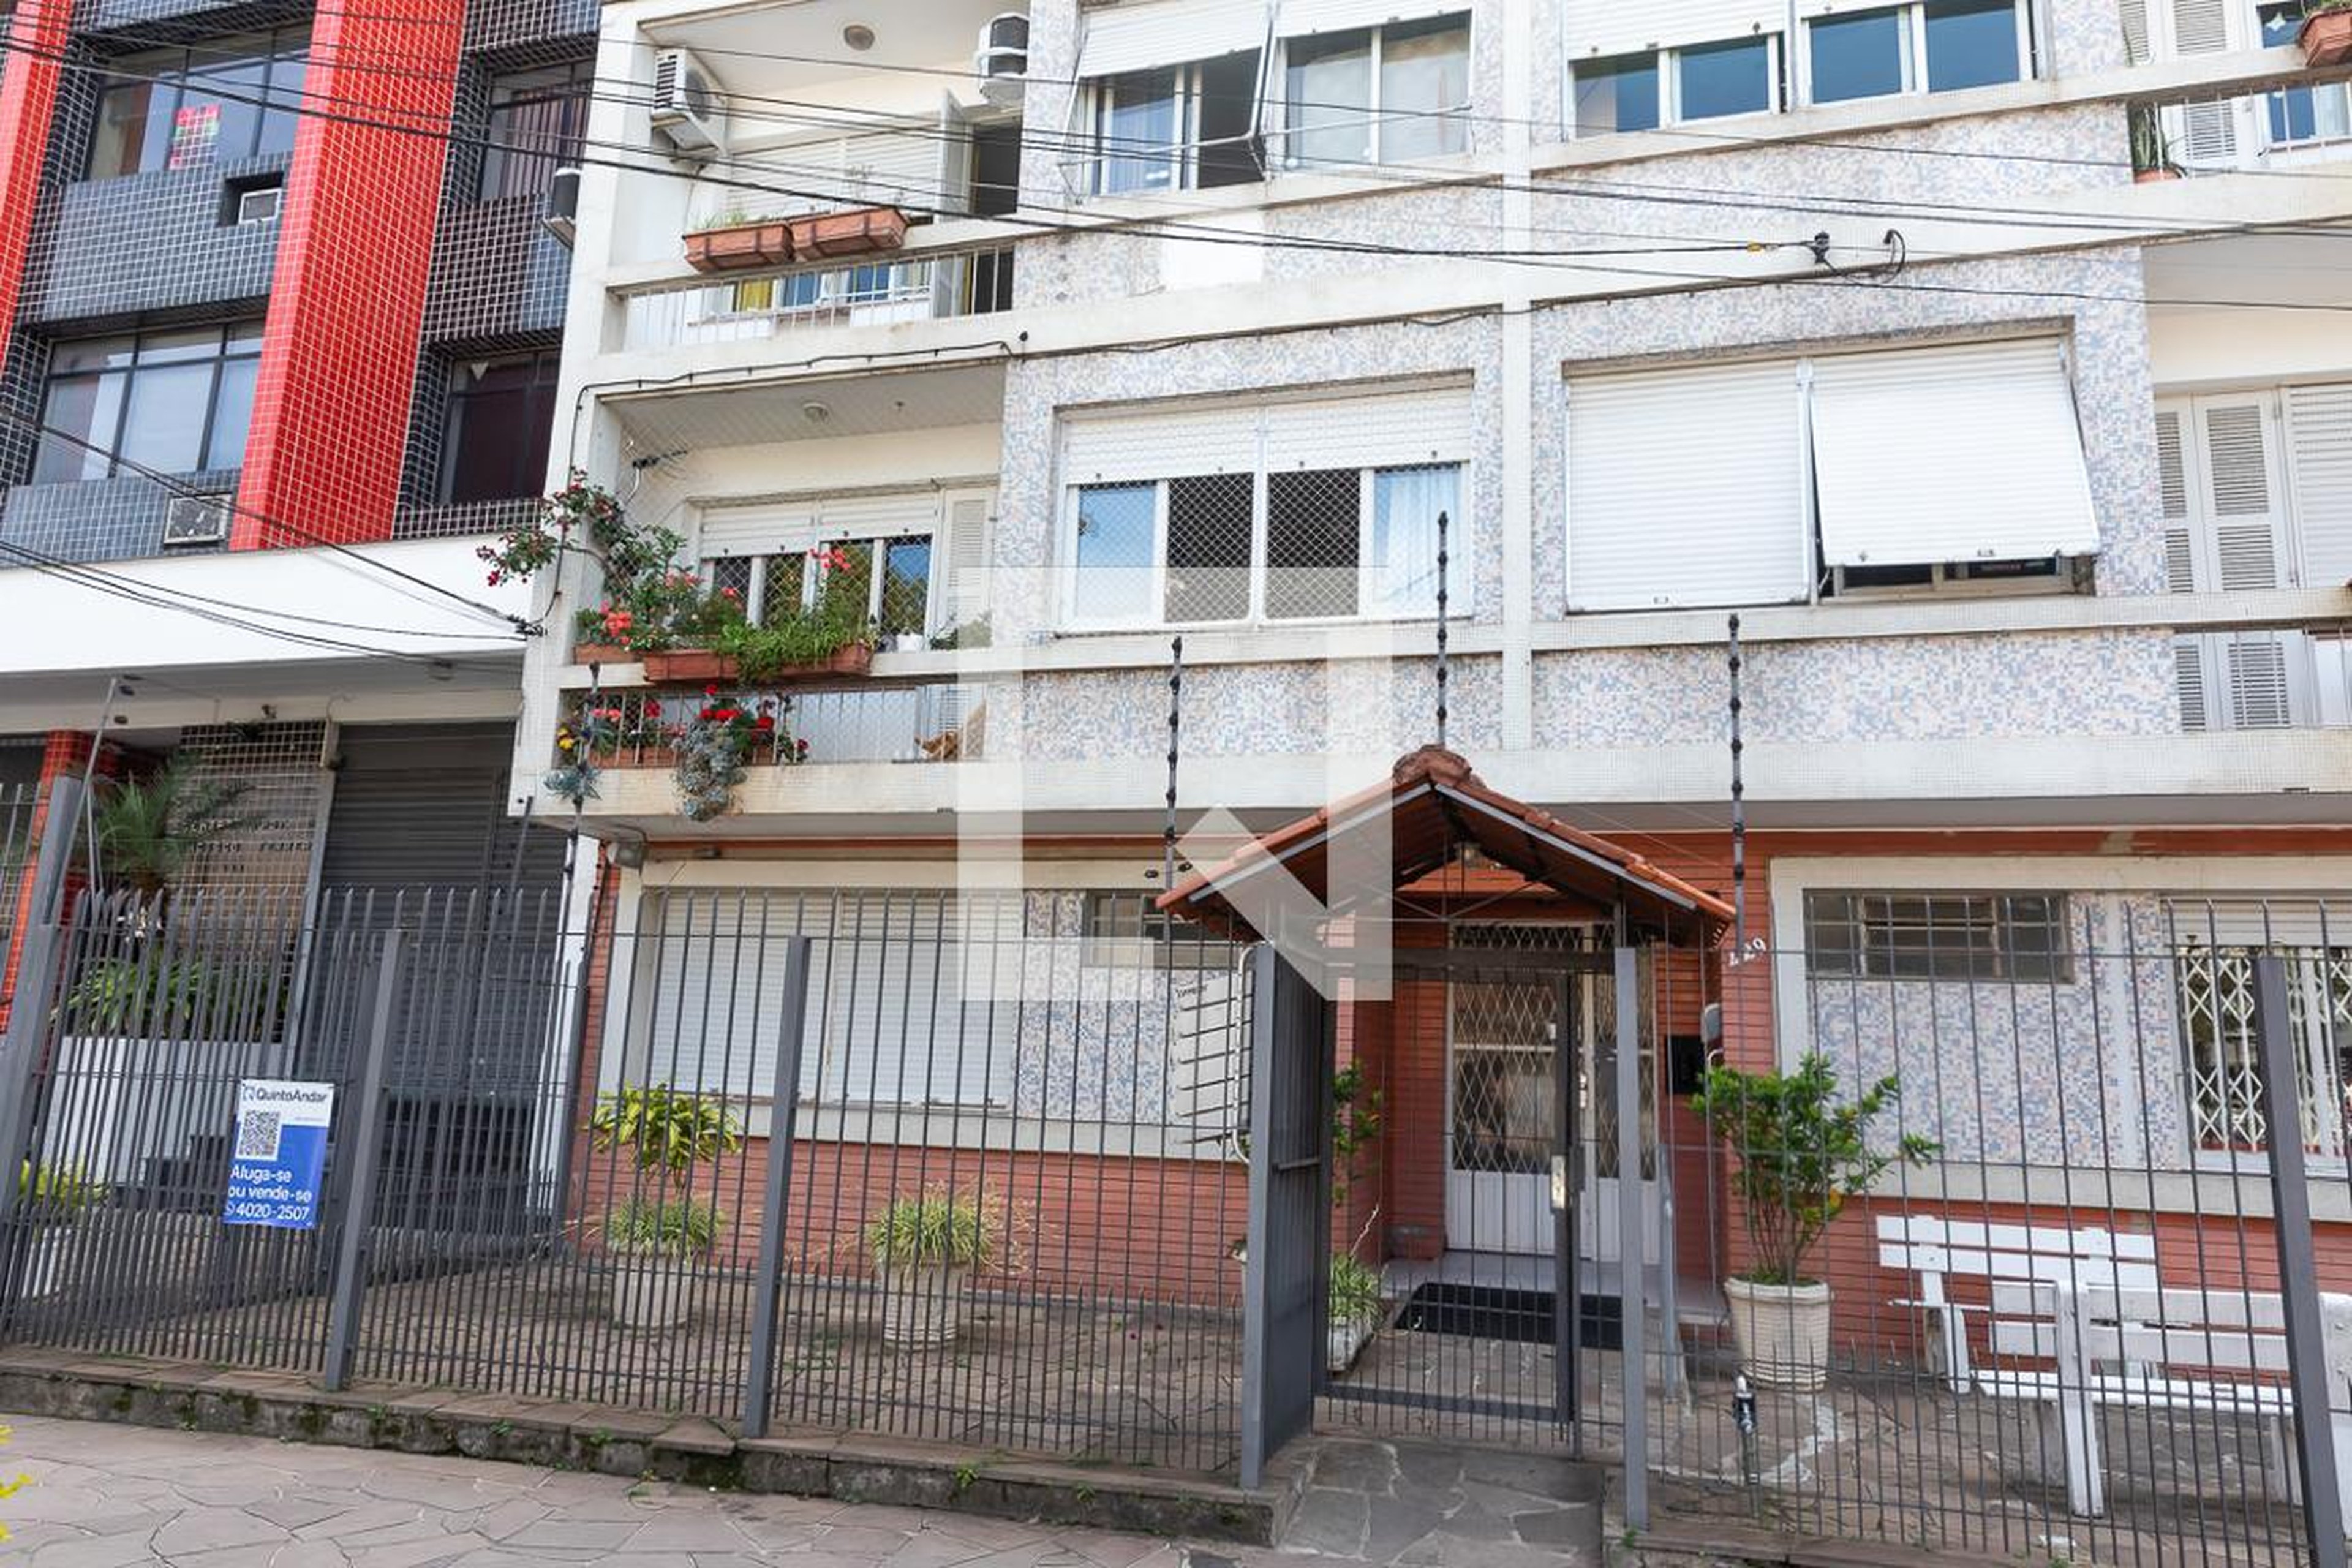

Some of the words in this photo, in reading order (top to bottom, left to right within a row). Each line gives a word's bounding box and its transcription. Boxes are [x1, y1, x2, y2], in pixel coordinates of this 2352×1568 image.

[257, 1088, 327, 1102] QuintoAndar
[230, 1164, 292, 1185] Aluga-se
[228, 1186, 246, 1198] ou
[248, 1185, 312, 1204] vende-se
[236, 1202, 311, 1221] 4020-2507
